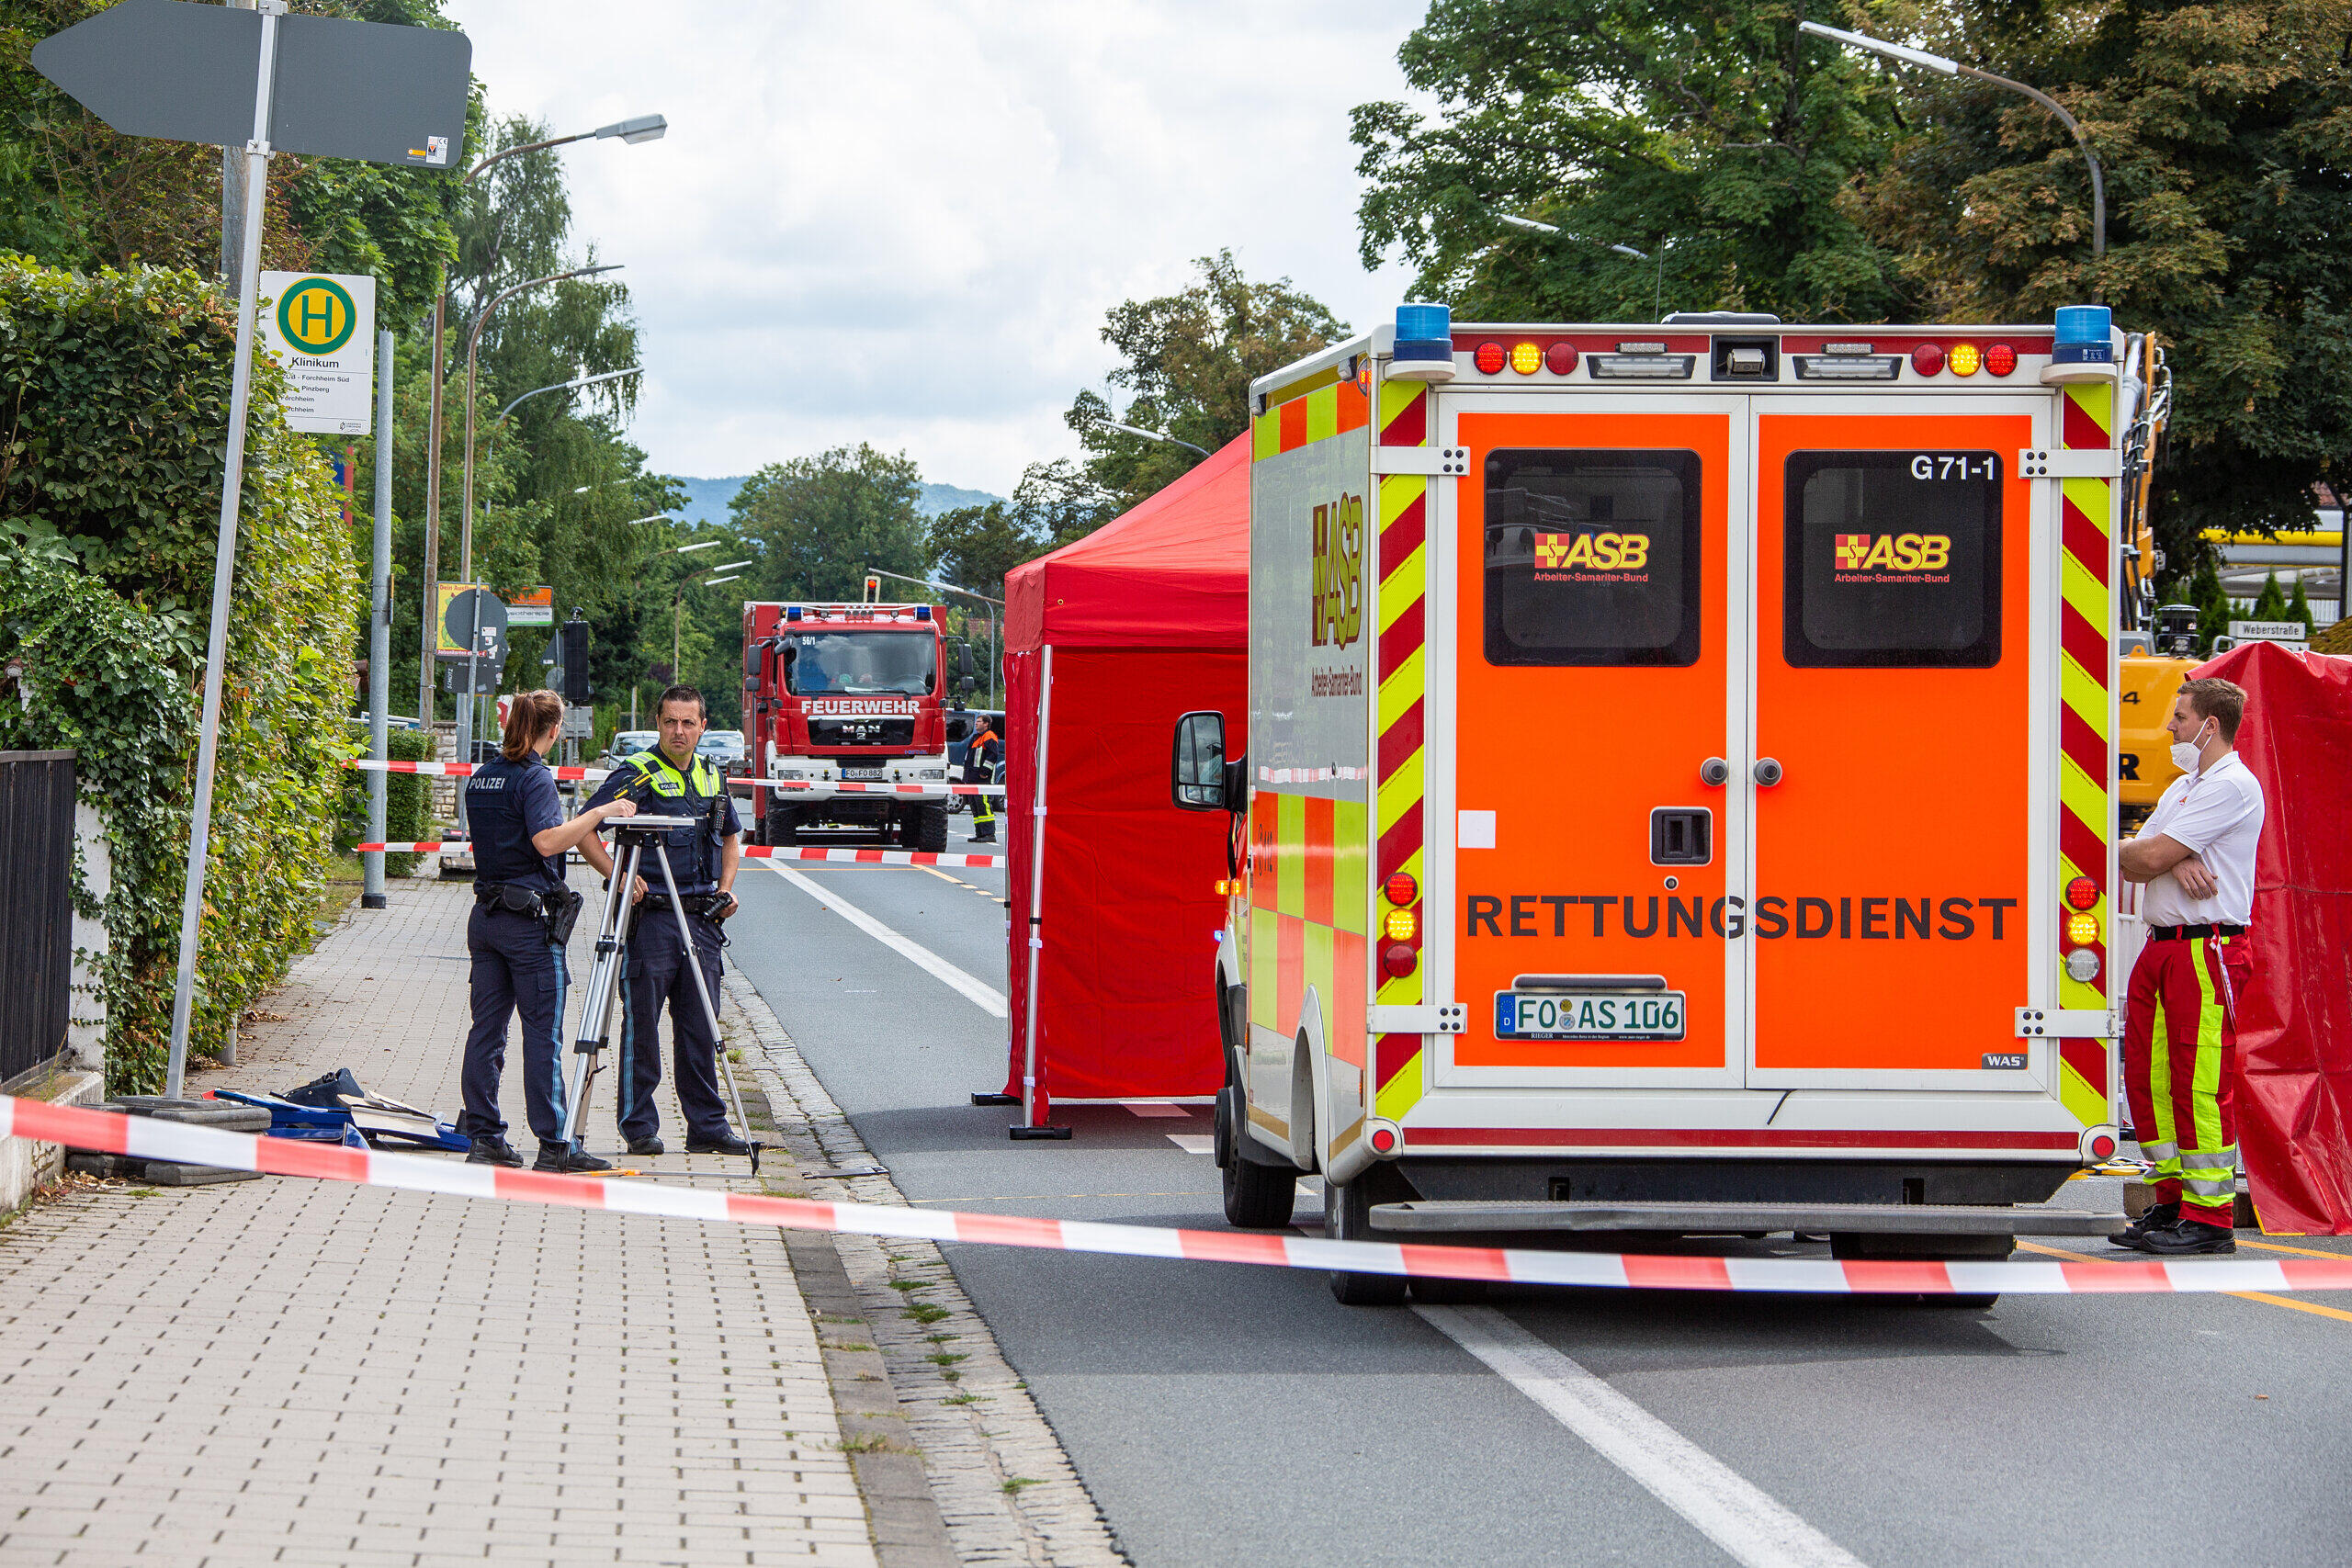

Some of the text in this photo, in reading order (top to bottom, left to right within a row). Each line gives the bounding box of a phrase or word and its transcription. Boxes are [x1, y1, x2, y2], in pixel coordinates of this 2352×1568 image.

[301, 295, 333, 338] H
[291, 356, 339, 368] Klinikum
[1911, 456, 1994, 479] G 71-1
[1560, 532, 1650, 570] ASB
[1860, 533, 1951, 571] ASB
[1323, 491, 1363, 651] ASB
[1533, 572, 1649, 582] Arbeiter-Samariter-Bund
[1835, 573, 1951, 583] Arbeiter-Samariter-Bund
[2243, 625, 2300, 637] Weberstraße
[802, 637, 816, 646] 56/1
[1311, 664, 1363, 697] Arbeiter-Samariter-Bund
[801, 701, 921, 714] FEUERWEHR
[842, 725, 881, 733] MAN
[469, 777, 506, 790] POLIZEI
[1467, 894, 2018, 941] RETTUNGSDIENST
[1503, 999, 1679, 1030] D FO AS 106
[1987, 1055, 2021, 1066] WAS
